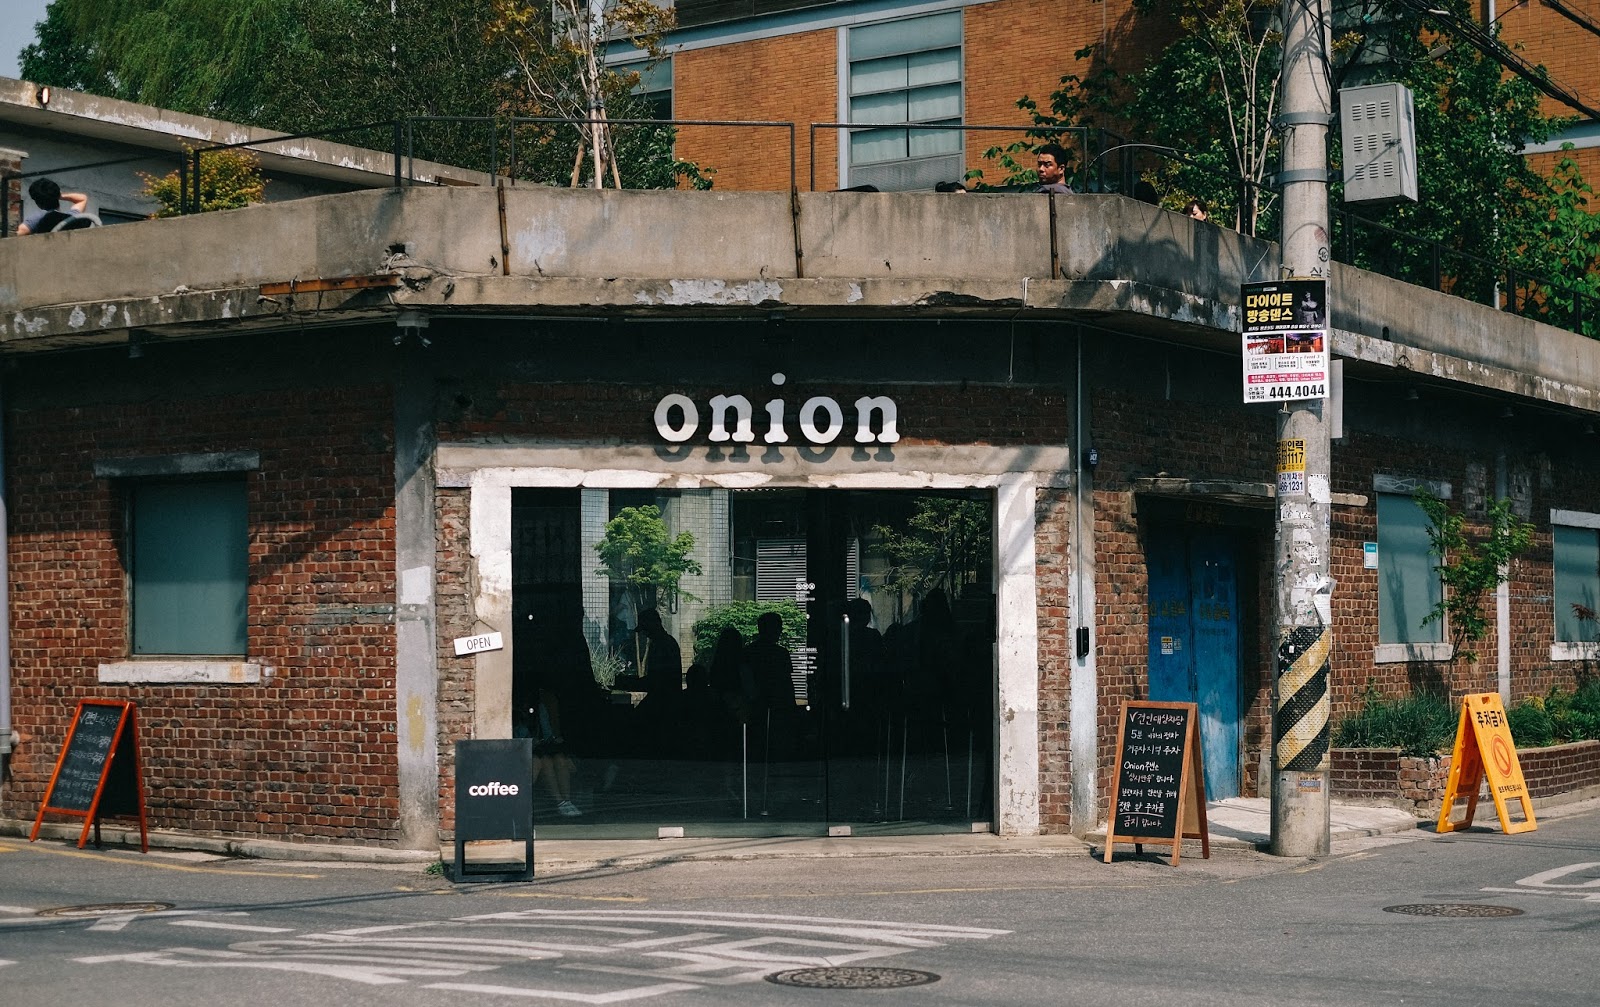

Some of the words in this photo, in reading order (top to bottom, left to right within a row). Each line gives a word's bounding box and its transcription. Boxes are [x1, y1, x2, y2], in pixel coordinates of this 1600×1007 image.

[1246, 293, 1293, 308] 다이어트
[1246, 308, 1293, 323] 방송댄스
[1269, 384, 1325, 398] 444.4044
[653, 372, 901, 444] onion
[466, 636, 492, 651] OPEN
[1476, 709, 1506, 728] 주차금지
[468, 781, 519, 796] coffee
[1123, 815, 1139, 828] 금지
